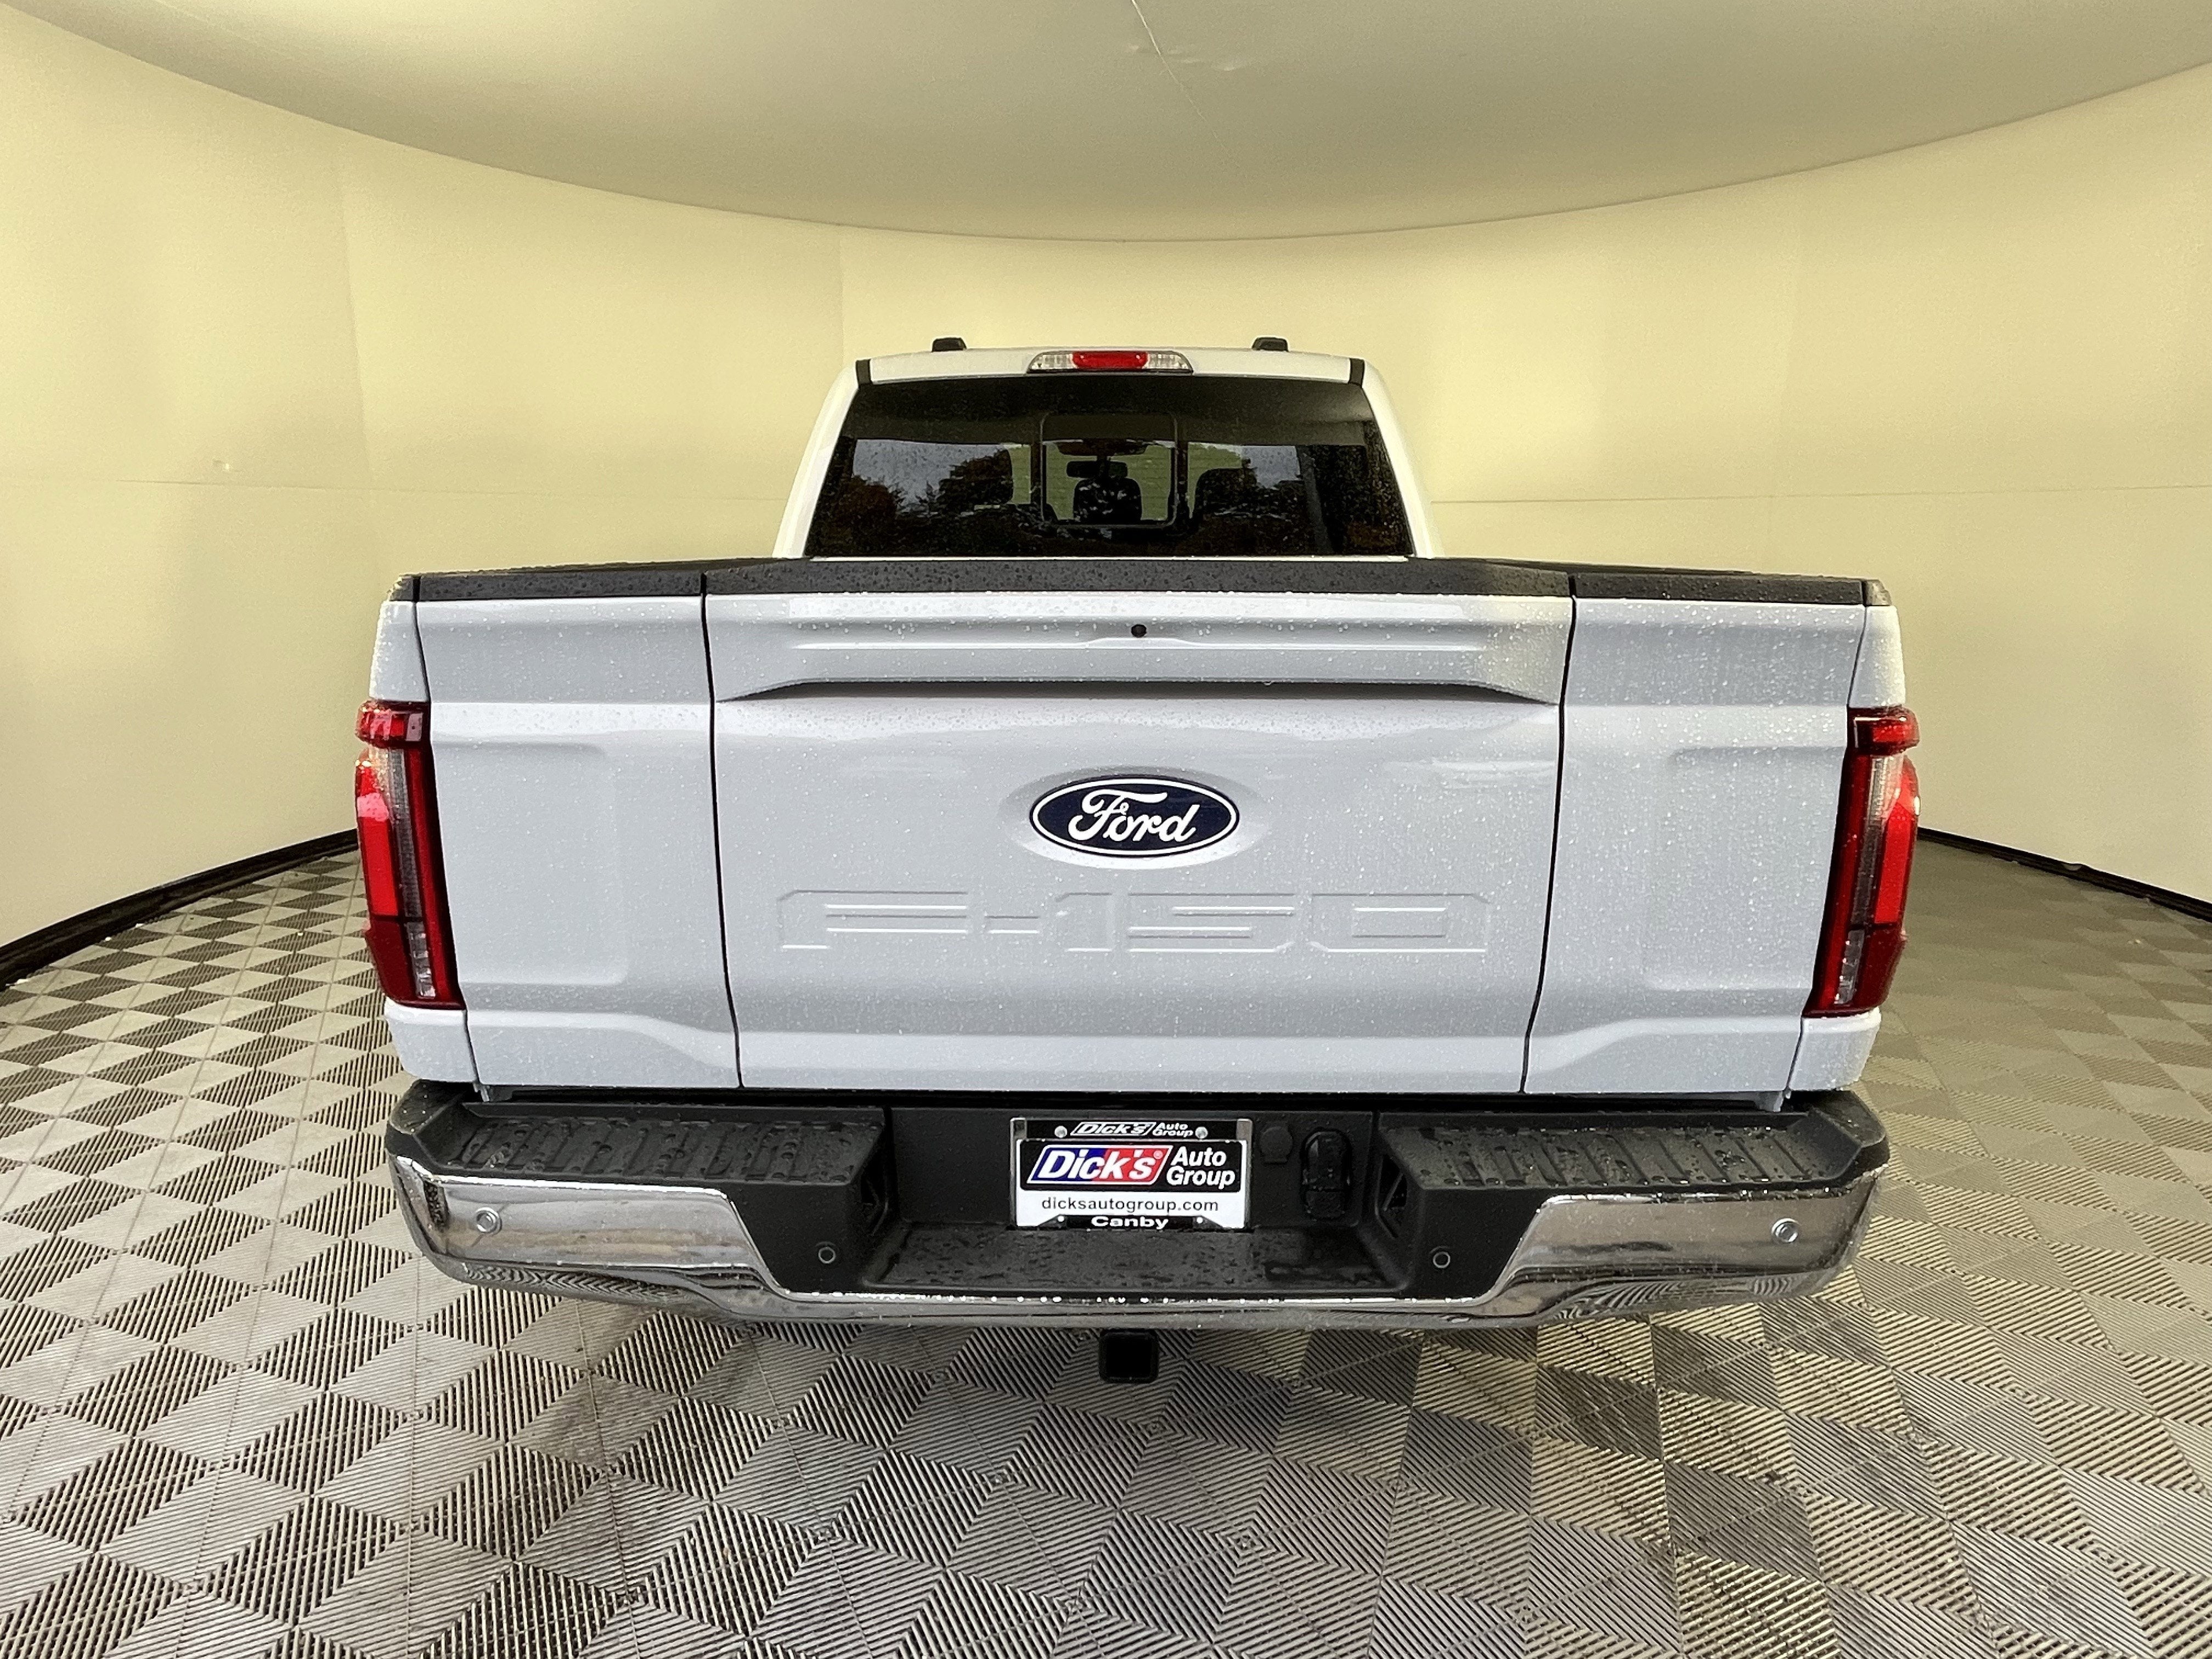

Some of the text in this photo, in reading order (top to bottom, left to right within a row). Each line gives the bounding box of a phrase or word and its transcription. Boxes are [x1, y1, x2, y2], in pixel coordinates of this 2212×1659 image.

[1068, 789, 1200, 842] Ford
[778, 888, 1491, 952] F-150
[1076, 1123, 1150, 1134] Dick's
[1153, 1129, 1194, 1137] Group
[1037, 1149, 1156, 1180] Dick's
[1171, 1146, 1227, 1166] Auto
[1166, 1167, 1235, 1189] Group
[1041, 1197, 1218, 1214] dicksautogroup.com
[1091, 1215, 1169, 1230] Canby
